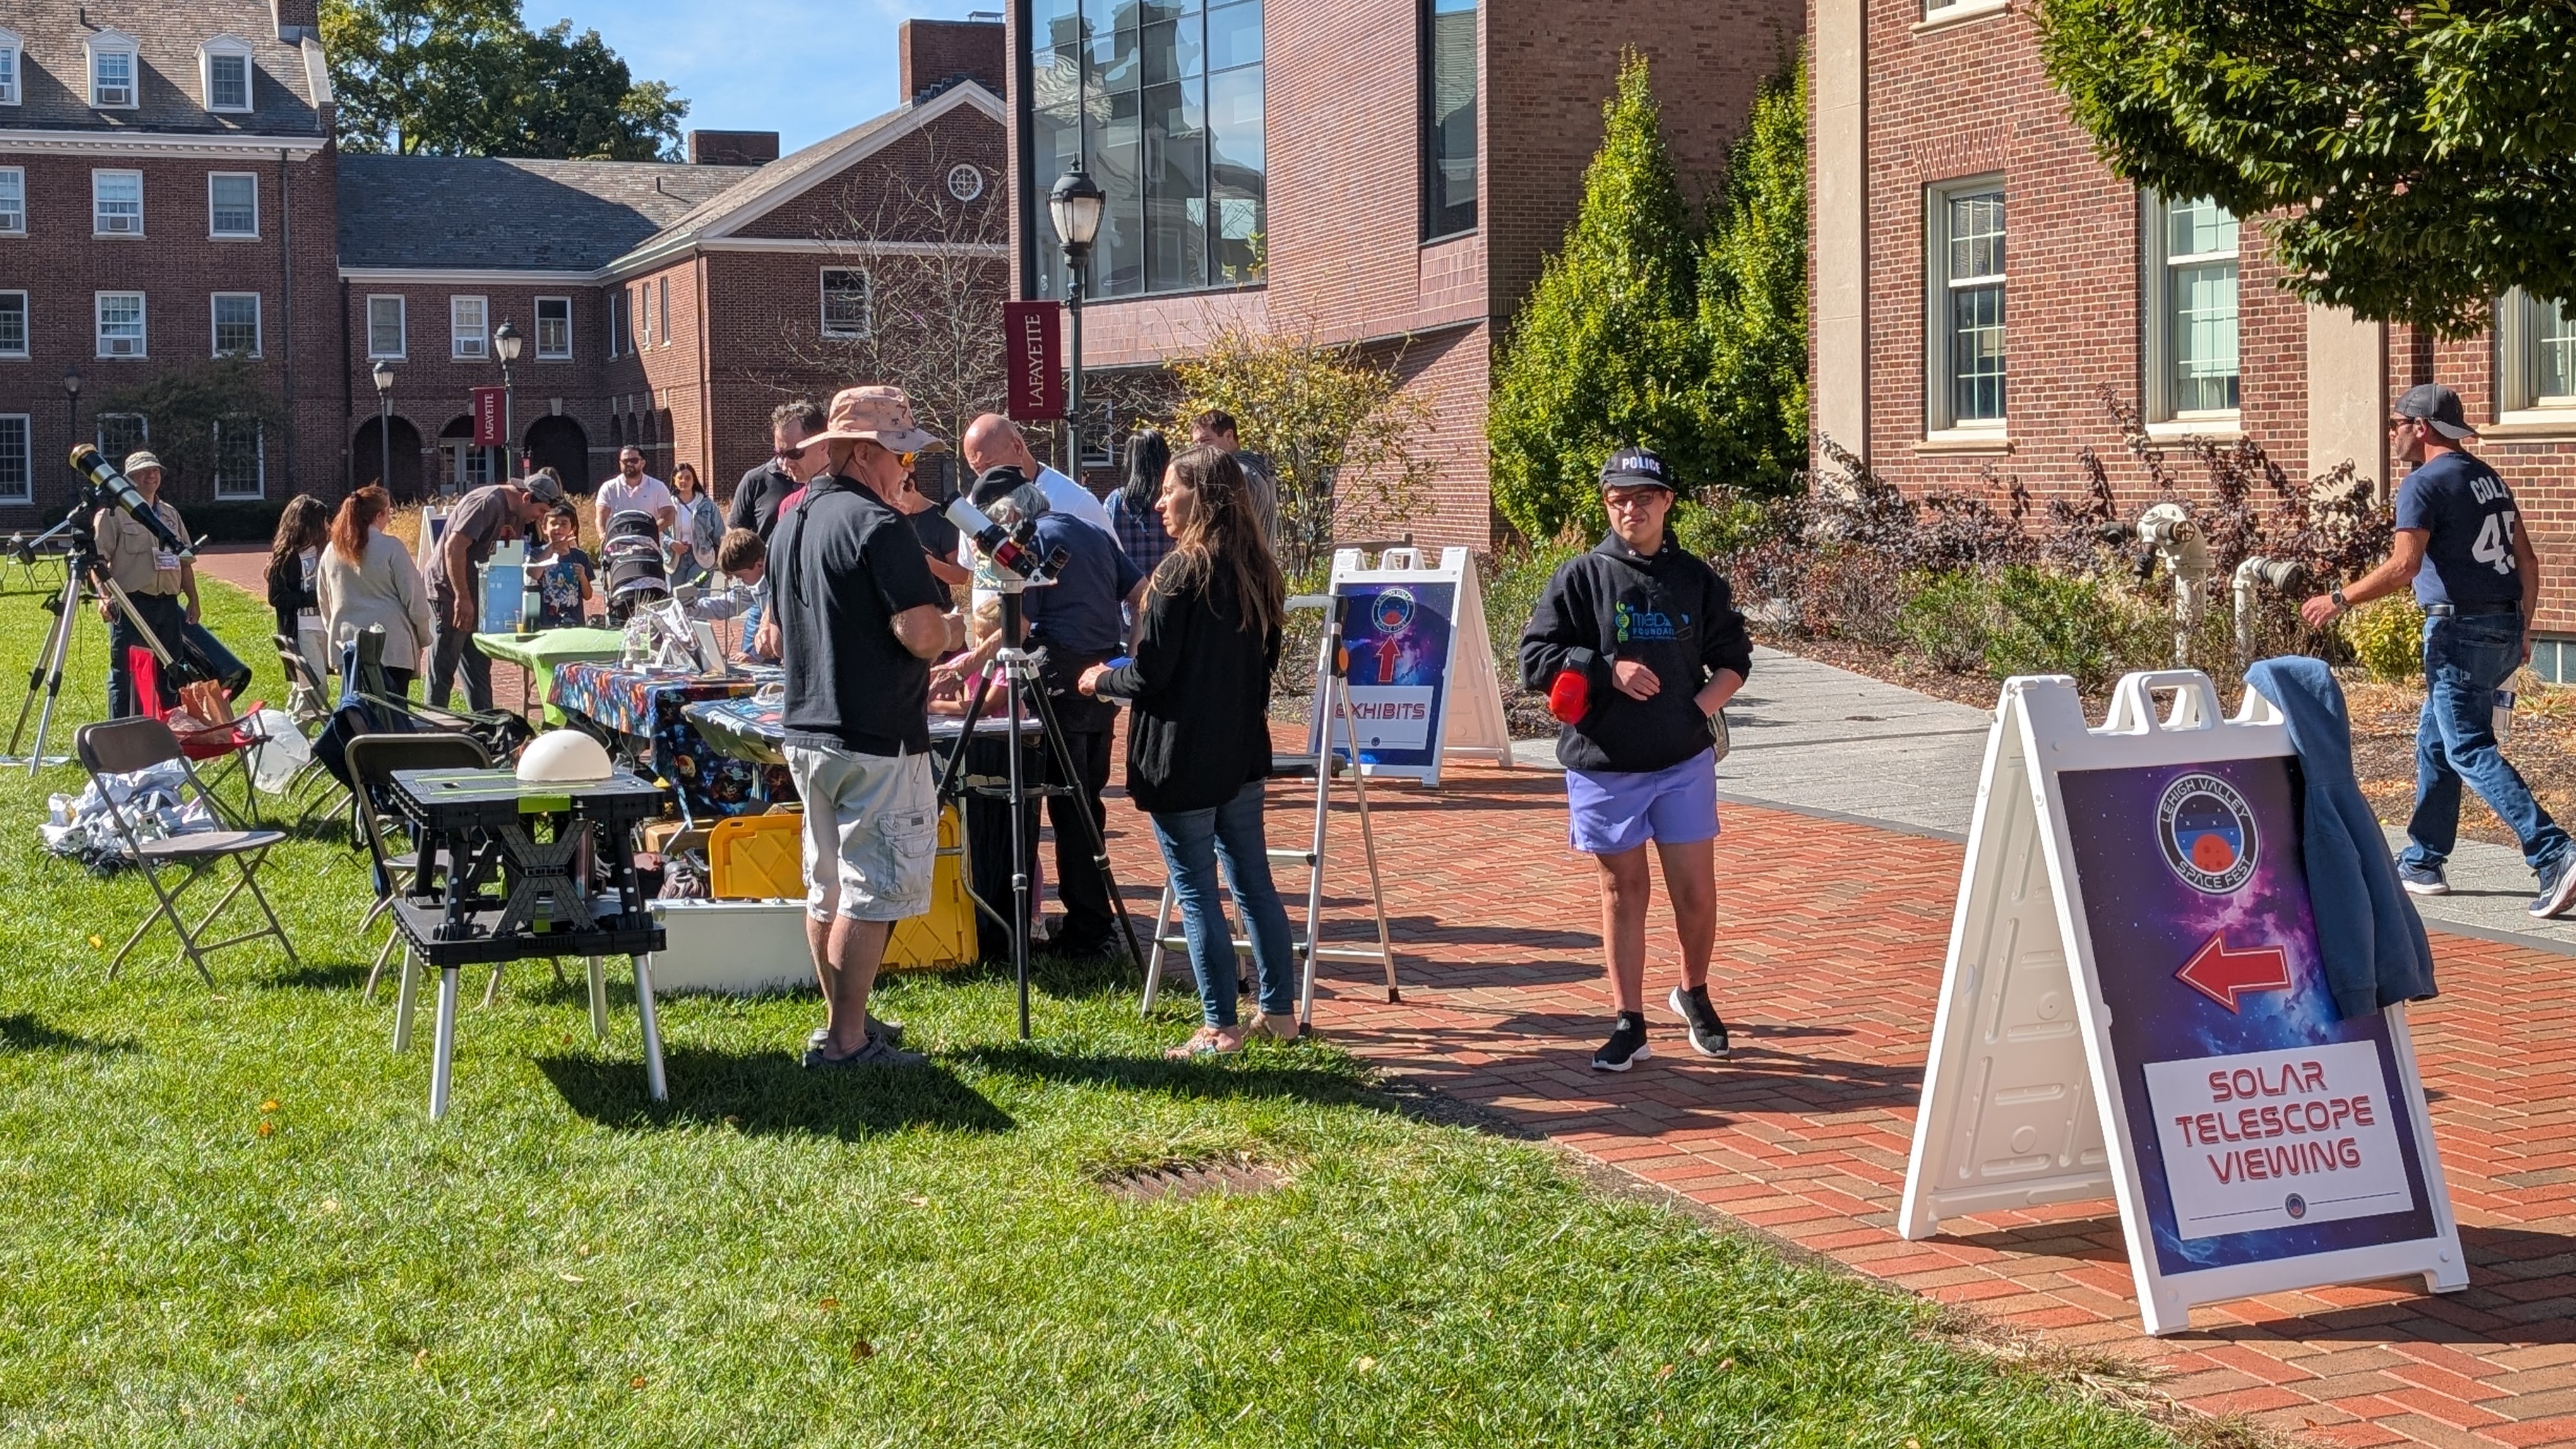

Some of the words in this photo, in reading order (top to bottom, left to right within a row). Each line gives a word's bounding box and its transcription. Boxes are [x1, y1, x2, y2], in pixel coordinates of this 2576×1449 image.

[1025, 314, 1044, 408] LAFAYETTE
[484, 393, 494, 439] LAFAYETTE
[1622, 456, 1662, 475] POLICE
[2161, 780, 2196, 823] LEHIGH
[2198, 779, 2248, 818] VALLEY
[2178, 861, 2222, 888] SPACE
[2225, 856, 2251, 885] FEST
[2209, 1061, 2328, 1102] SOLAR
[2175, 1095, 2375, 1147] TELESCOPE
[2207, 1137, 2361, 1184] VIEWING
